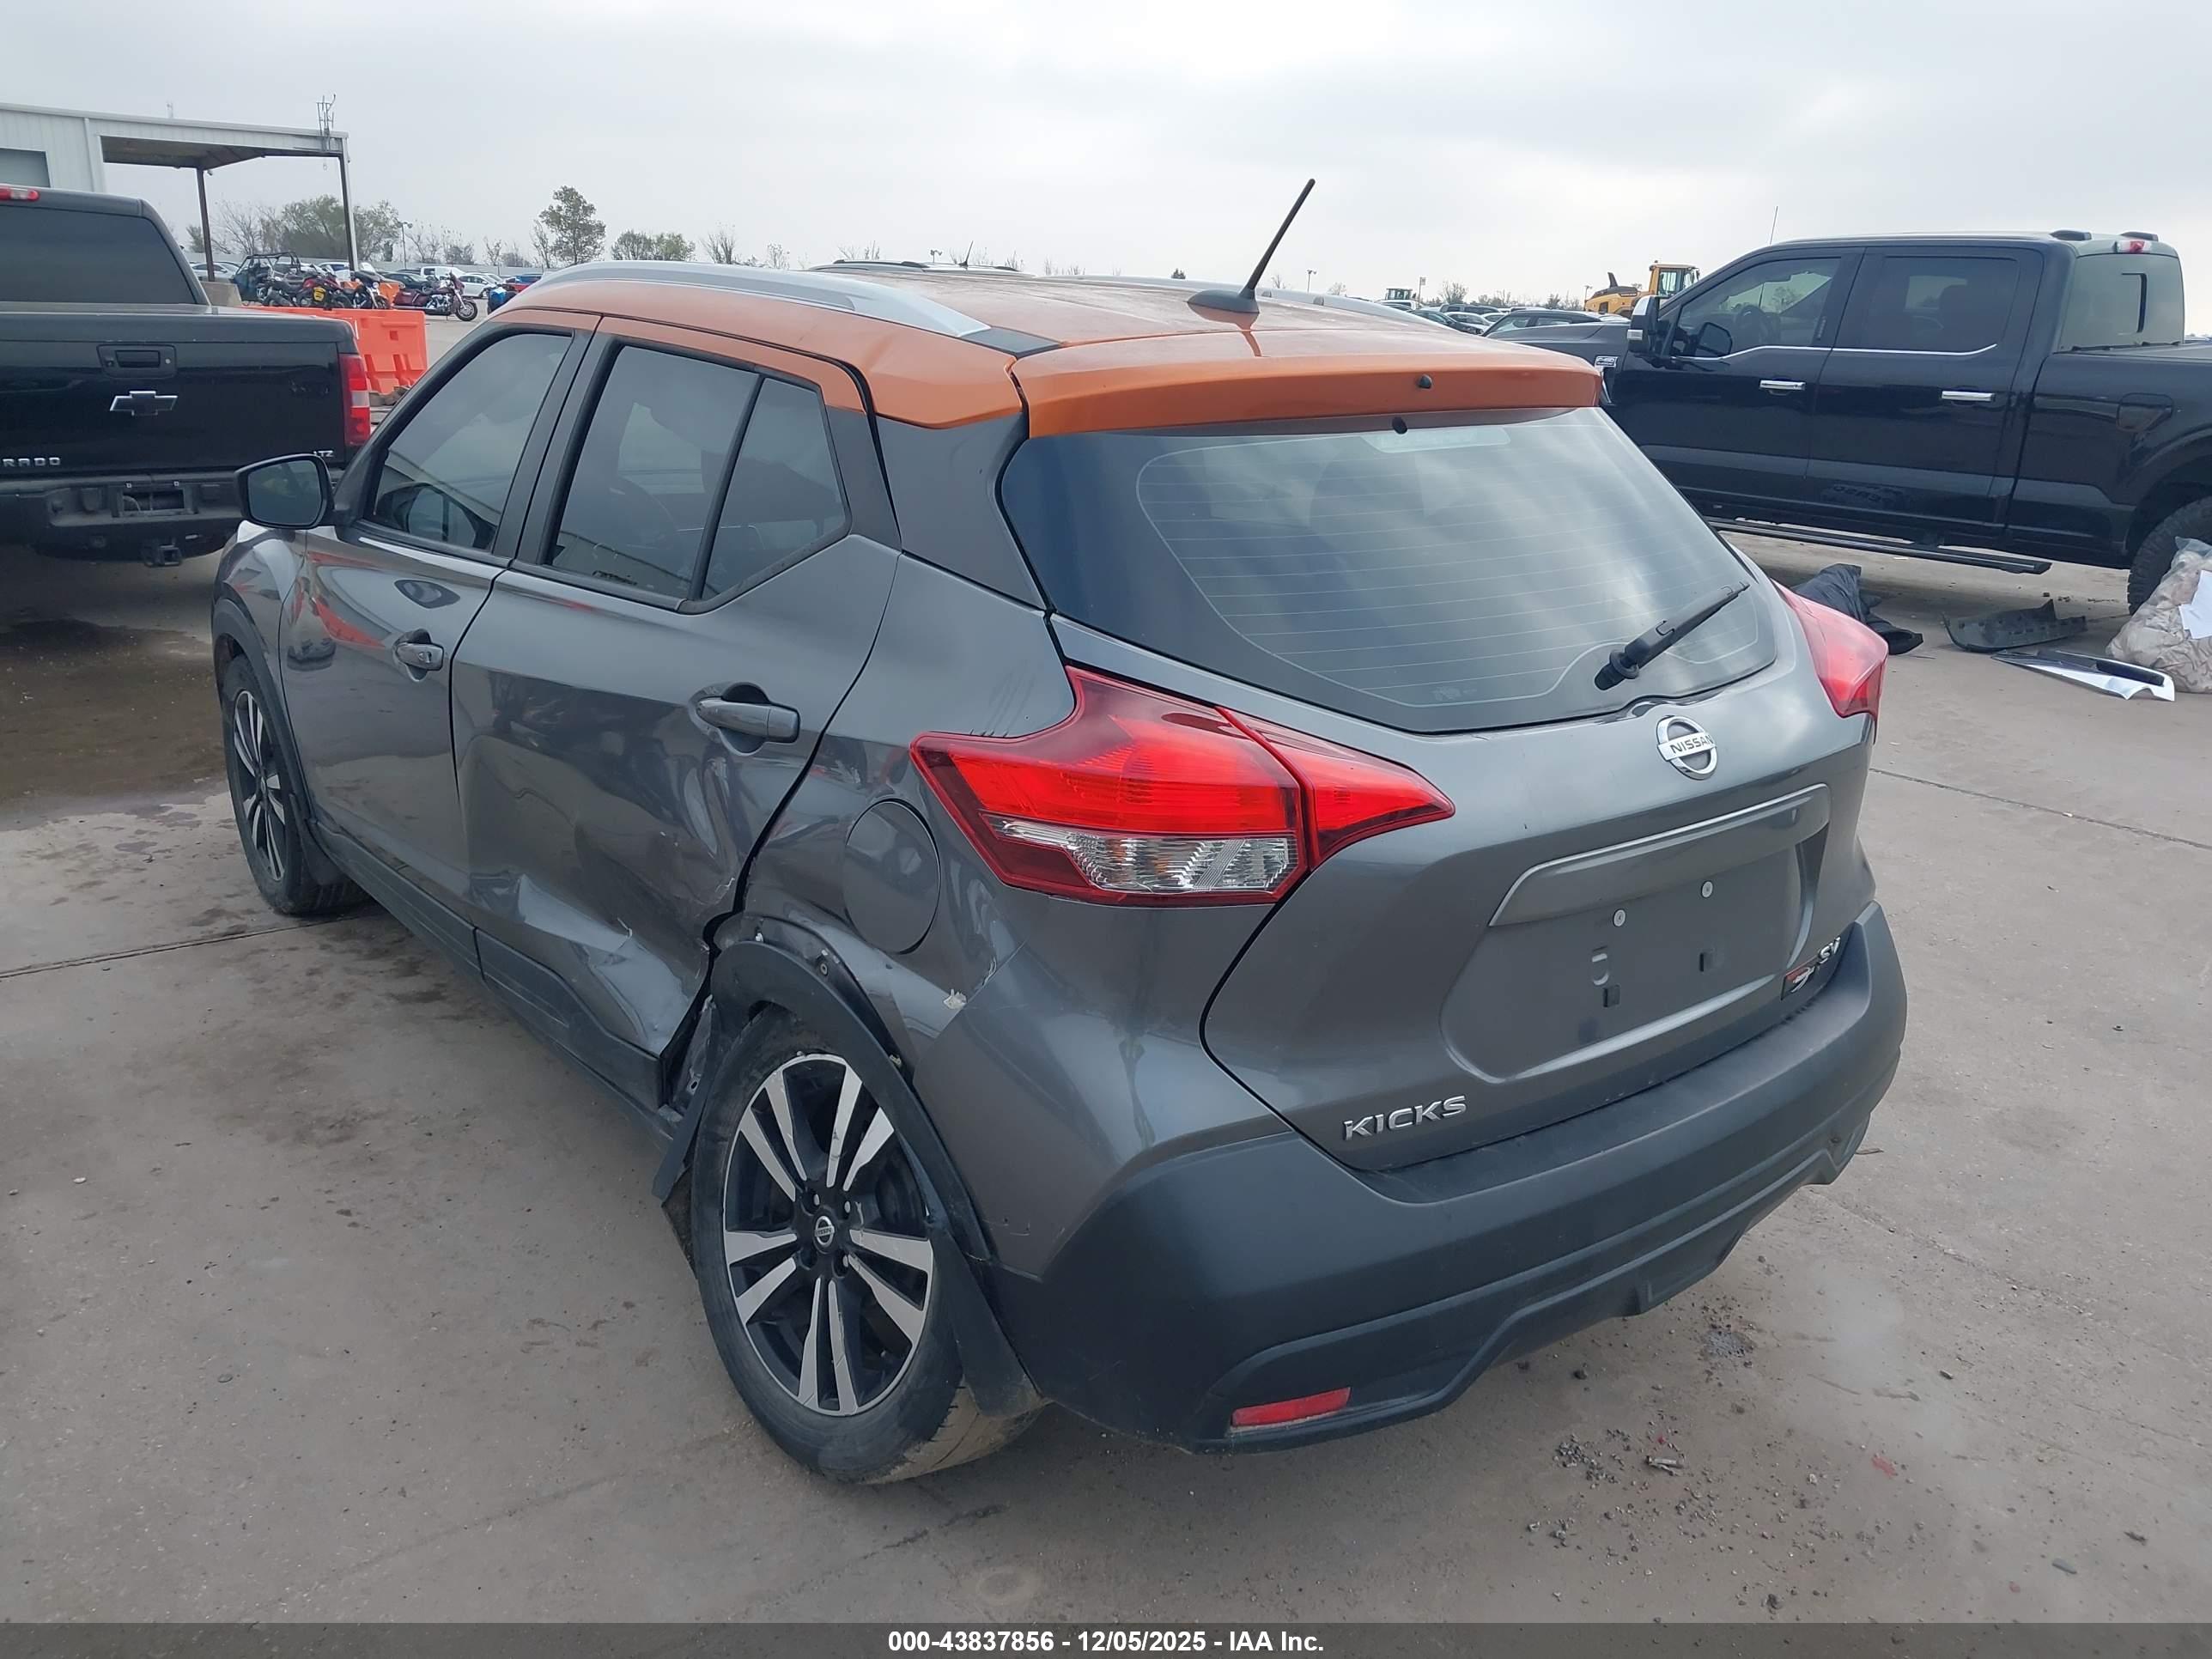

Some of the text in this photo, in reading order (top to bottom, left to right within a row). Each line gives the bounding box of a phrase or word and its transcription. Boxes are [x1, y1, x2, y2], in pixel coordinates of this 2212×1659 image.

[2, 457, 62, 467] RADO
[1669, 734, 1715, 753] NISSAN
[1819, 936, 1841, 964] SV
[1343, 1095, 1467, 1141] KICKS
